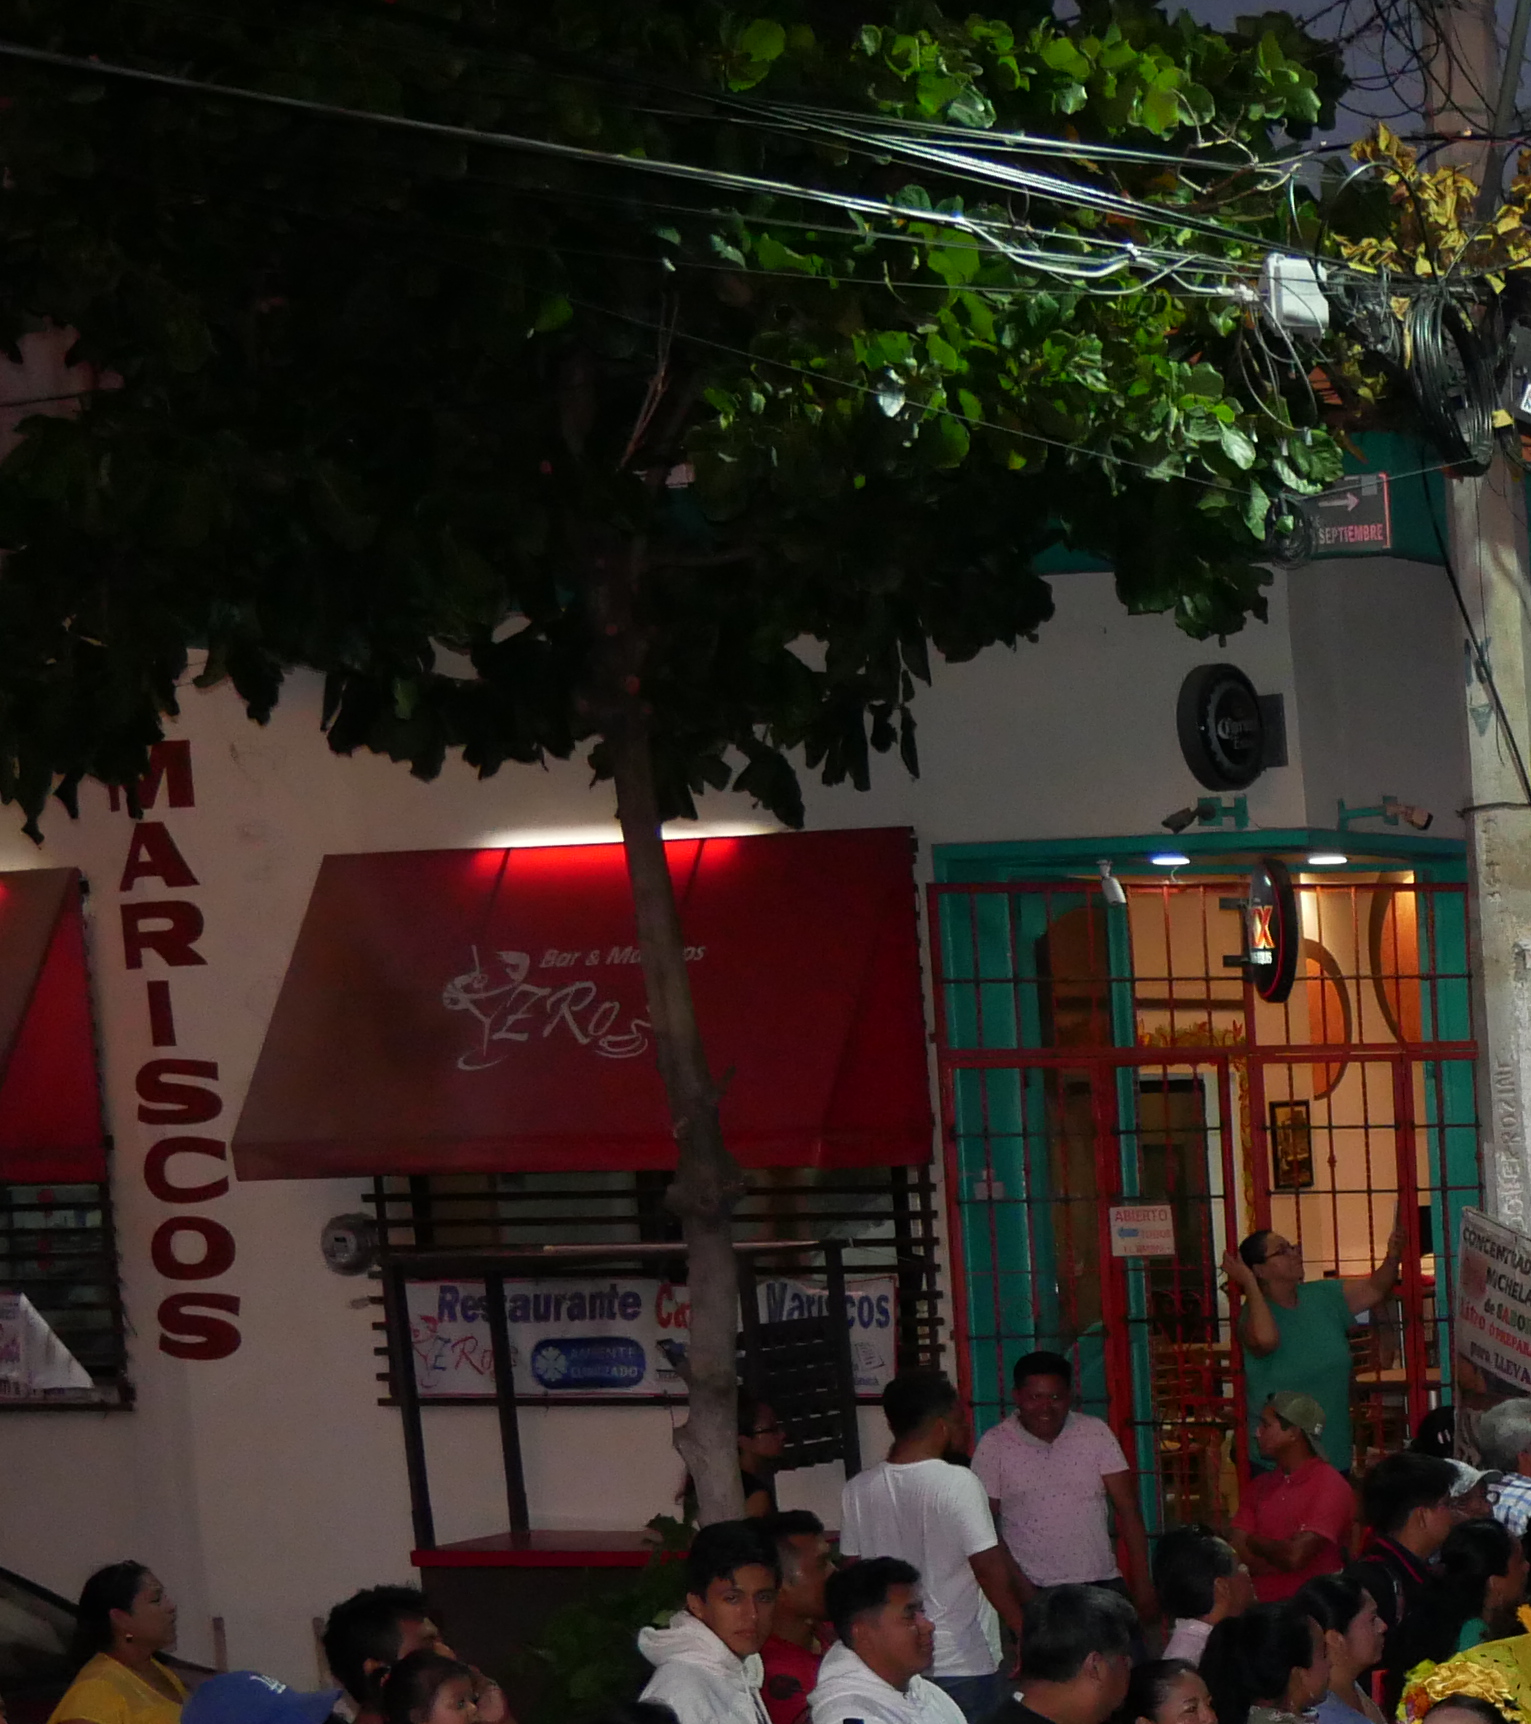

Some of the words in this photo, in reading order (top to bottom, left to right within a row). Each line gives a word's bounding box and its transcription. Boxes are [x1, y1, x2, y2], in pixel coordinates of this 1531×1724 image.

[1318, 523, 1384, 545] SEPTIEMBRE
[539, 949, 581, 969] Bar
[584, 949, 601, 966] &
